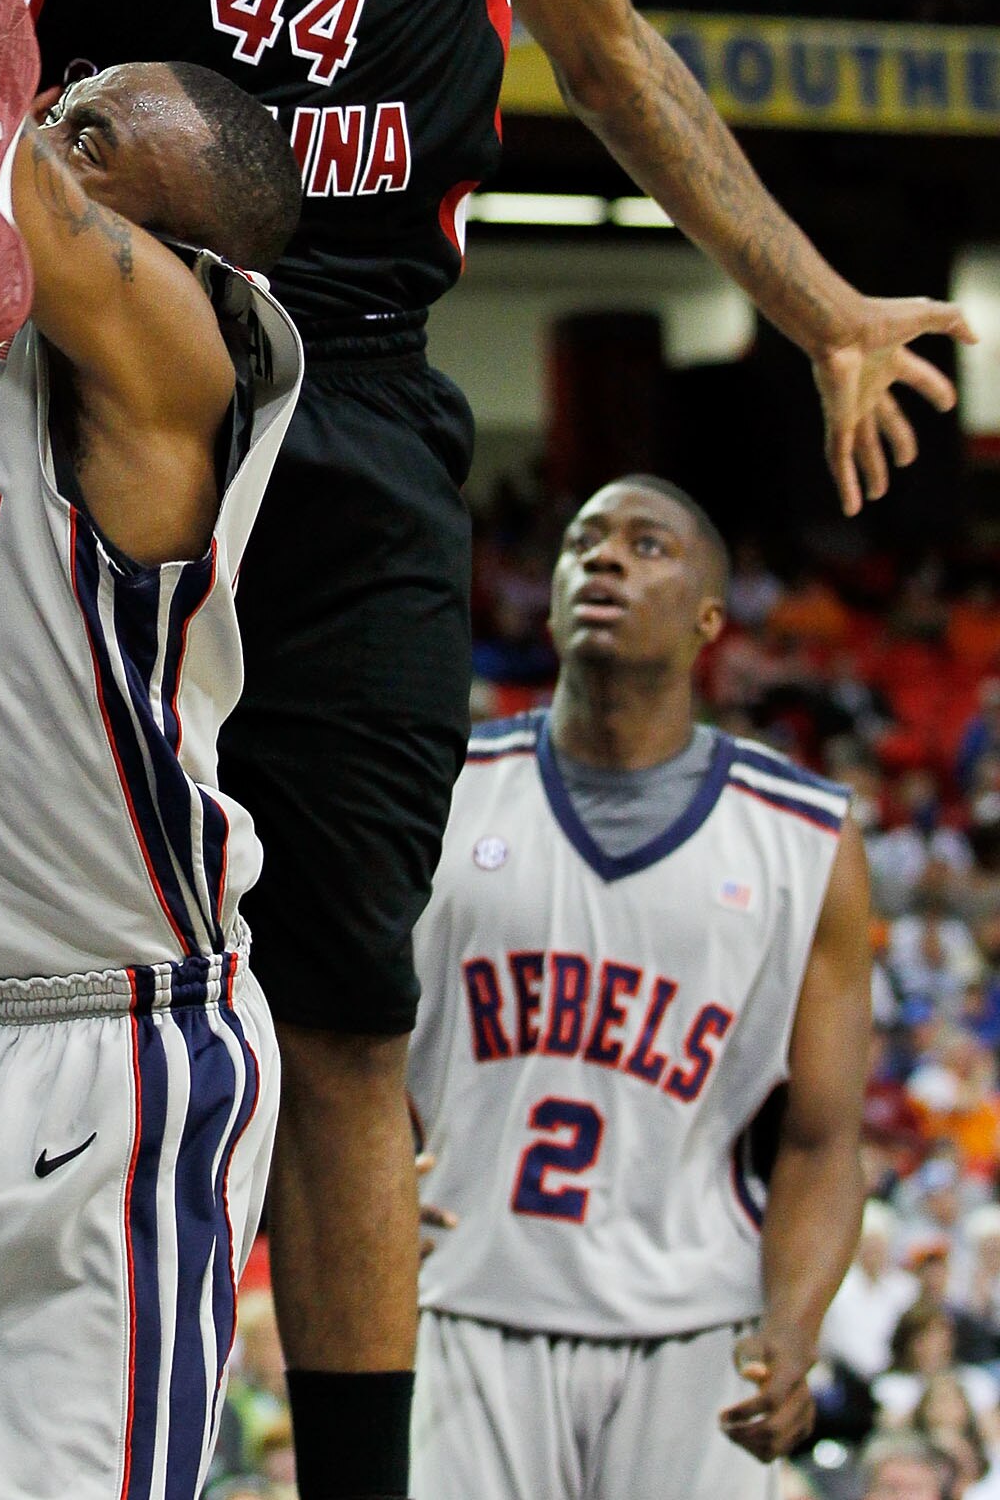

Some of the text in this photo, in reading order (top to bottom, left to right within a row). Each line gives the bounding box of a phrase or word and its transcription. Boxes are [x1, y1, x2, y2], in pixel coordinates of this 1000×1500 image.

[266, 101, 411, 198] INA
[462, 949, 735, 1104] REBELS
[511, 1095, 605, 1226] 2
